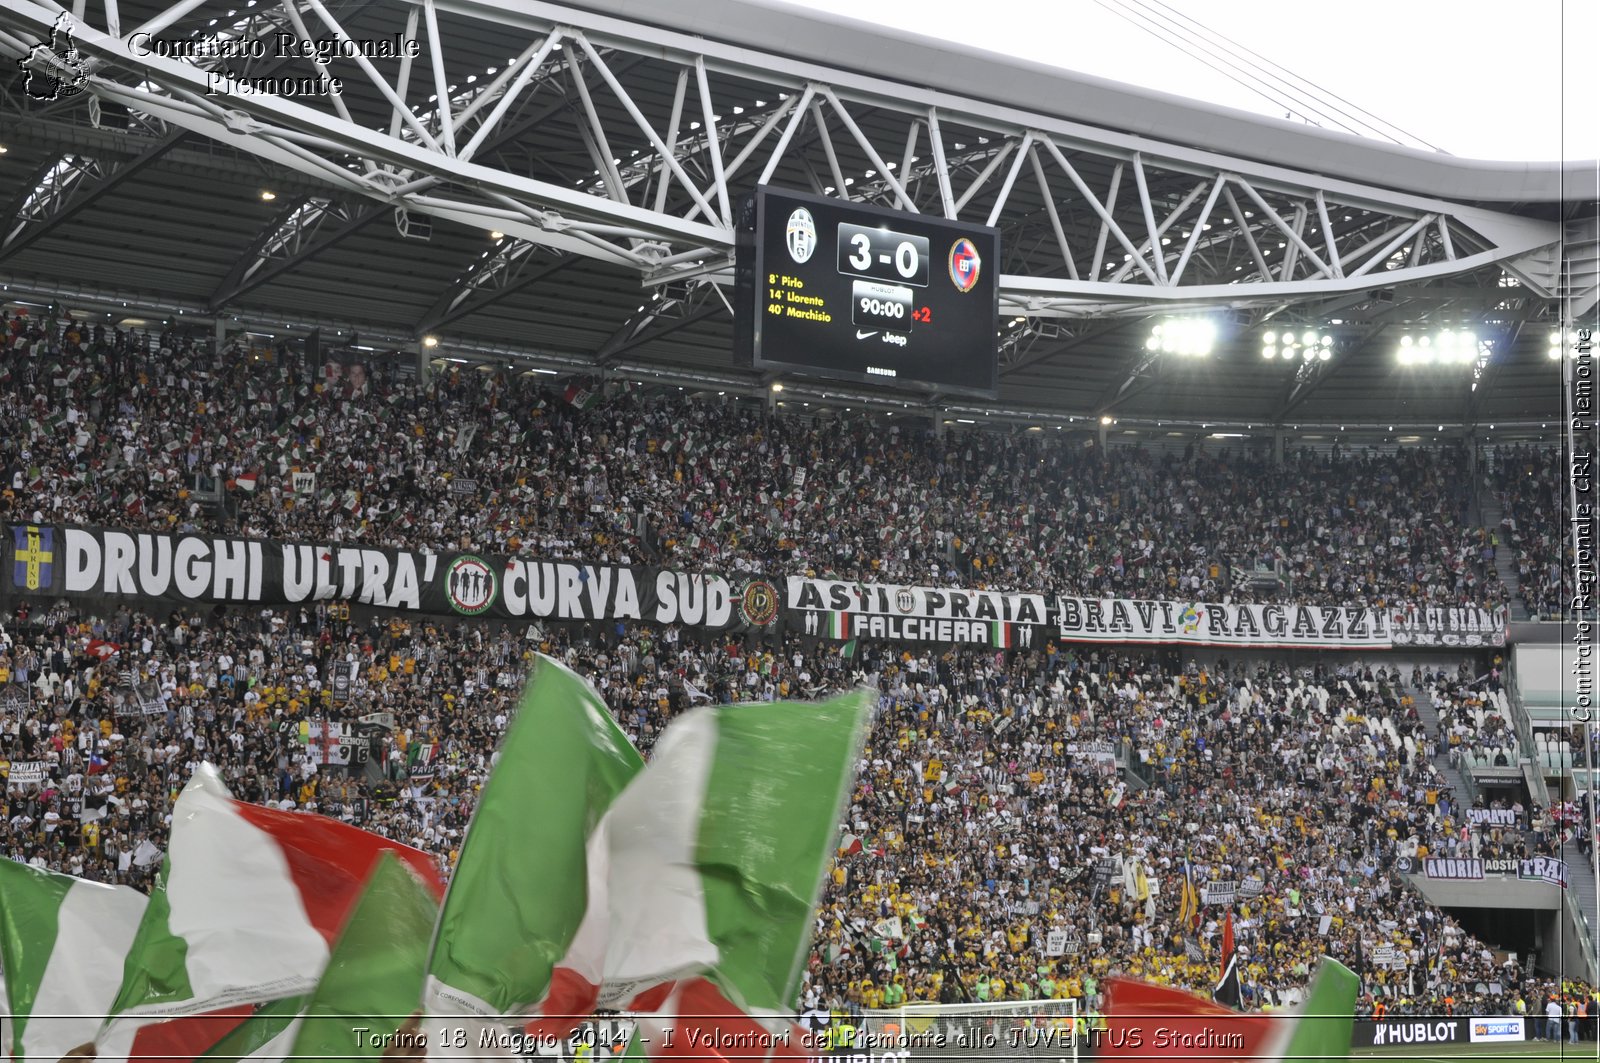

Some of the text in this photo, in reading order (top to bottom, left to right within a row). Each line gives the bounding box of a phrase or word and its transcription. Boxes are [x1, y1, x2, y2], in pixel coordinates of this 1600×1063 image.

[781, 275, 804, 289] Pirlo
[786, 291, 825, 307] Llorente
[786, 307, 832, 323] Marchisio
[860, 297, 904, 319] 90:00
[912, 306, 932, 323] +2
[882, 331, 907, 347] Jeep
[866, 366, 897, 378] SAMSUNG
[29, 539, 38, 586] TORINO
[64, 529, 263, 600] DRUGHI
[503, 557, 732, 627] CURVA SUD
[796, 581, 890, 613] ASTI
[925, 591, 1040, 623] PRAIA
[1061, 598, 1388, 639] BRAVI RAGAZZI
[1450, 607, 1505, 633] SIAMO
[854, 615, 988, 643] FALCHERA
[10, 762, 40, 772] EMILIA
[1427, 860, 1483, 878] ANDRIA
[1485, 860, 1519, 871] AOSTA
[1208, 882, 1234, 893] ANDRIA
[1389, 1022, 1457, 1043] HUBLOT
[1475, 1023, 1519, 1036] sky SPORT HD
